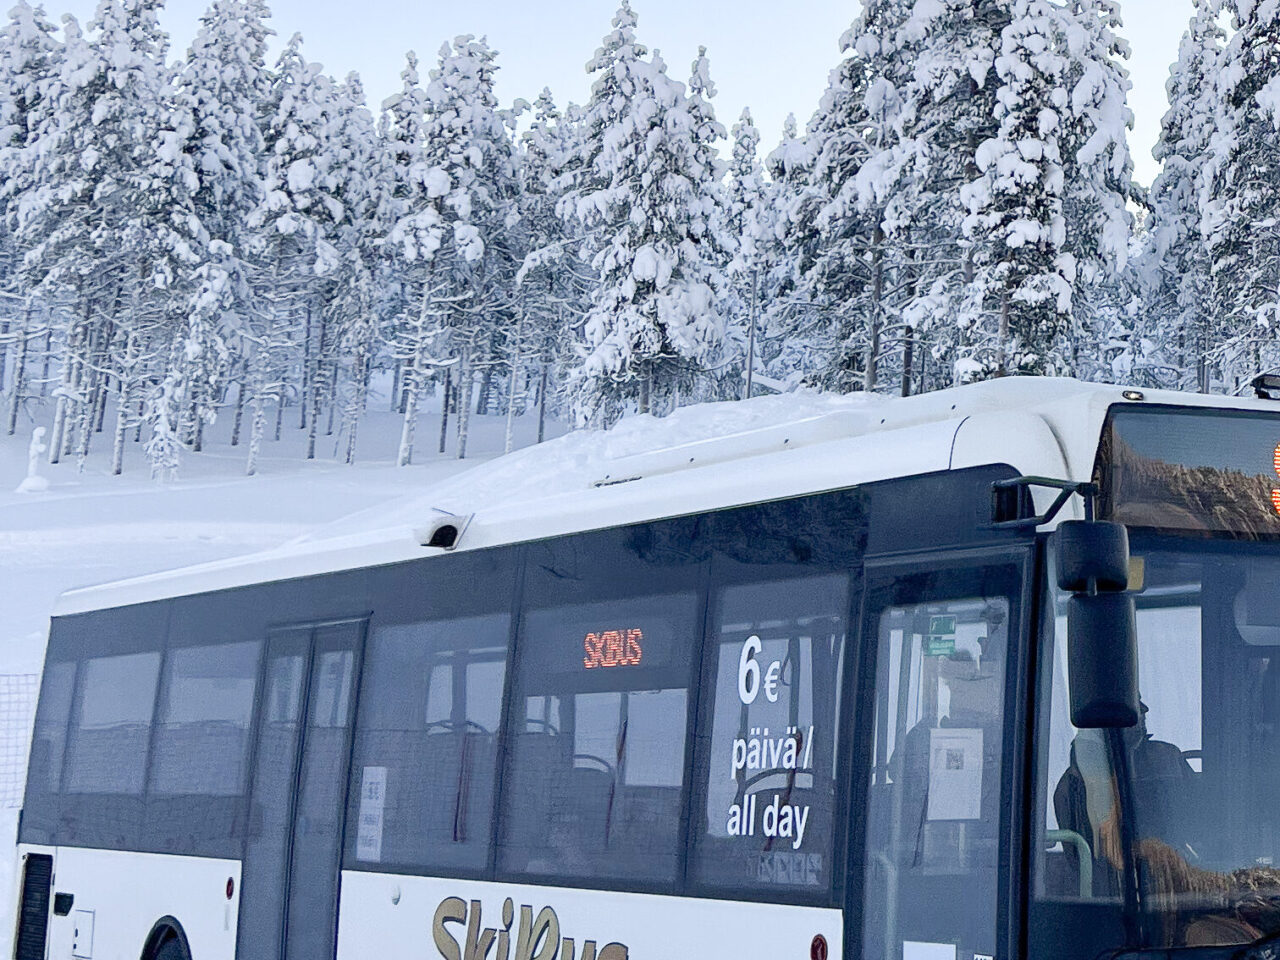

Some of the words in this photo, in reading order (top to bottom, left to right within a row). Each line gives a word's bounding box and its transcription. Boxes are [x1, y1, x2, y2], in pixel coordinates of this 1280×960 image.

[583, 628, 643, 669] SKIBUS
[726, 794, 757, 837] all
[763, 794, 810, 850] day
